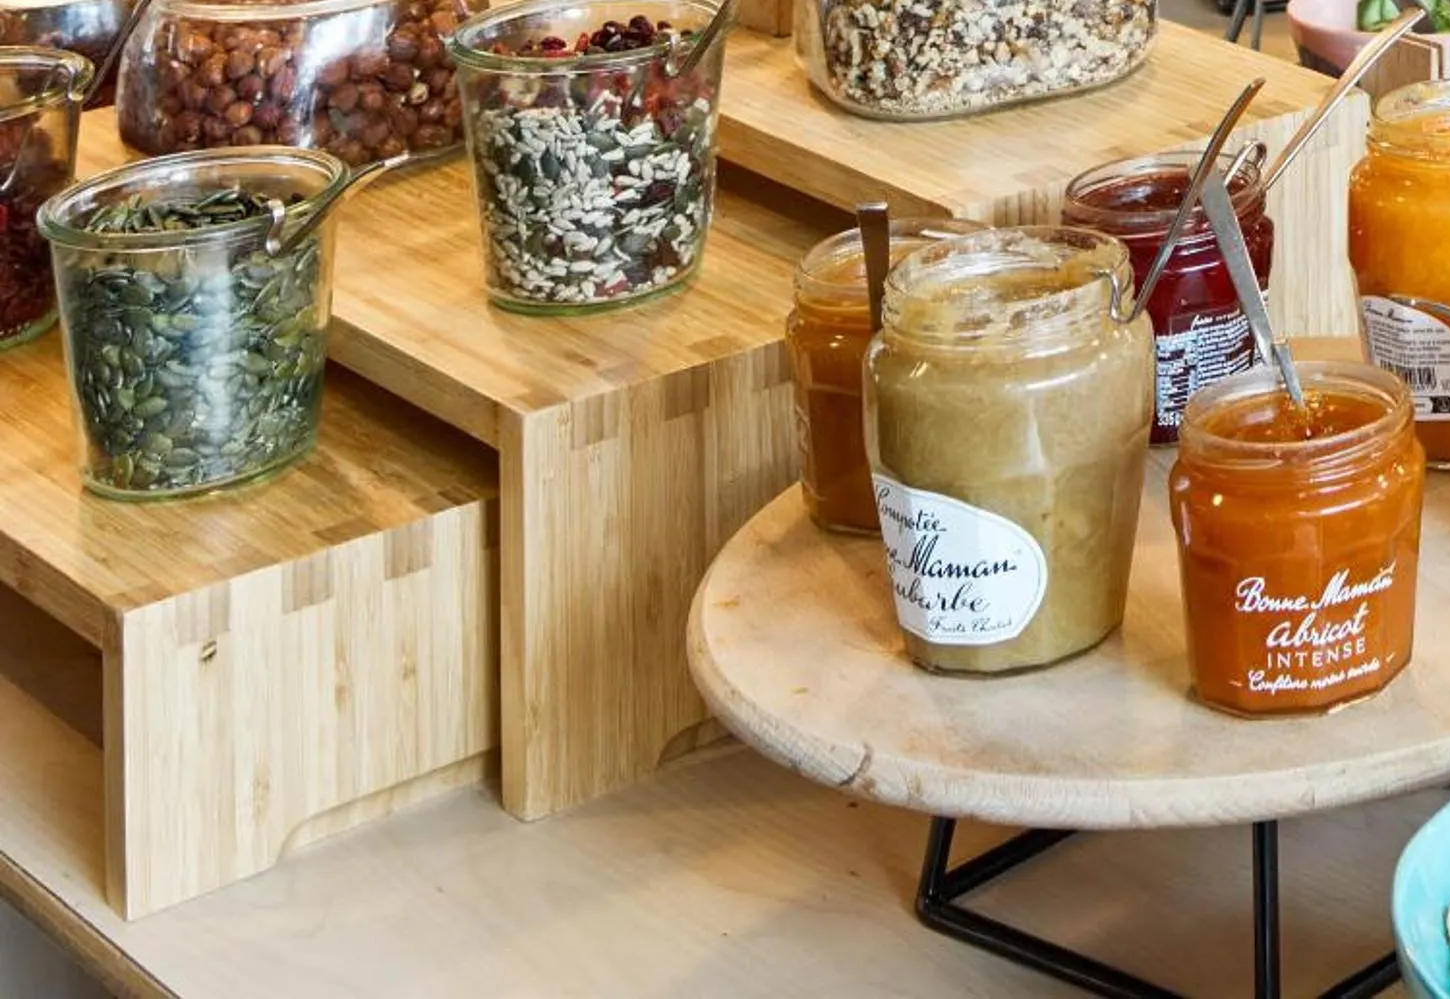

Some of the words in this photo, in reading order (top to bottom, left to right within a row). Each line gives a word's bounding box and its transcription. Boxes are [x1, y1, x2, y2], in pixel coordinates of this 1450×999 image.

[903, 533, 1018, 579] Maman
[895, 577, 991, 613] ubarbe
[1235, 576, 1311, 613] Bonne
[1310, 560, 1398, 610] Maman
[1267, 637, 1366, 669] INTENSE
